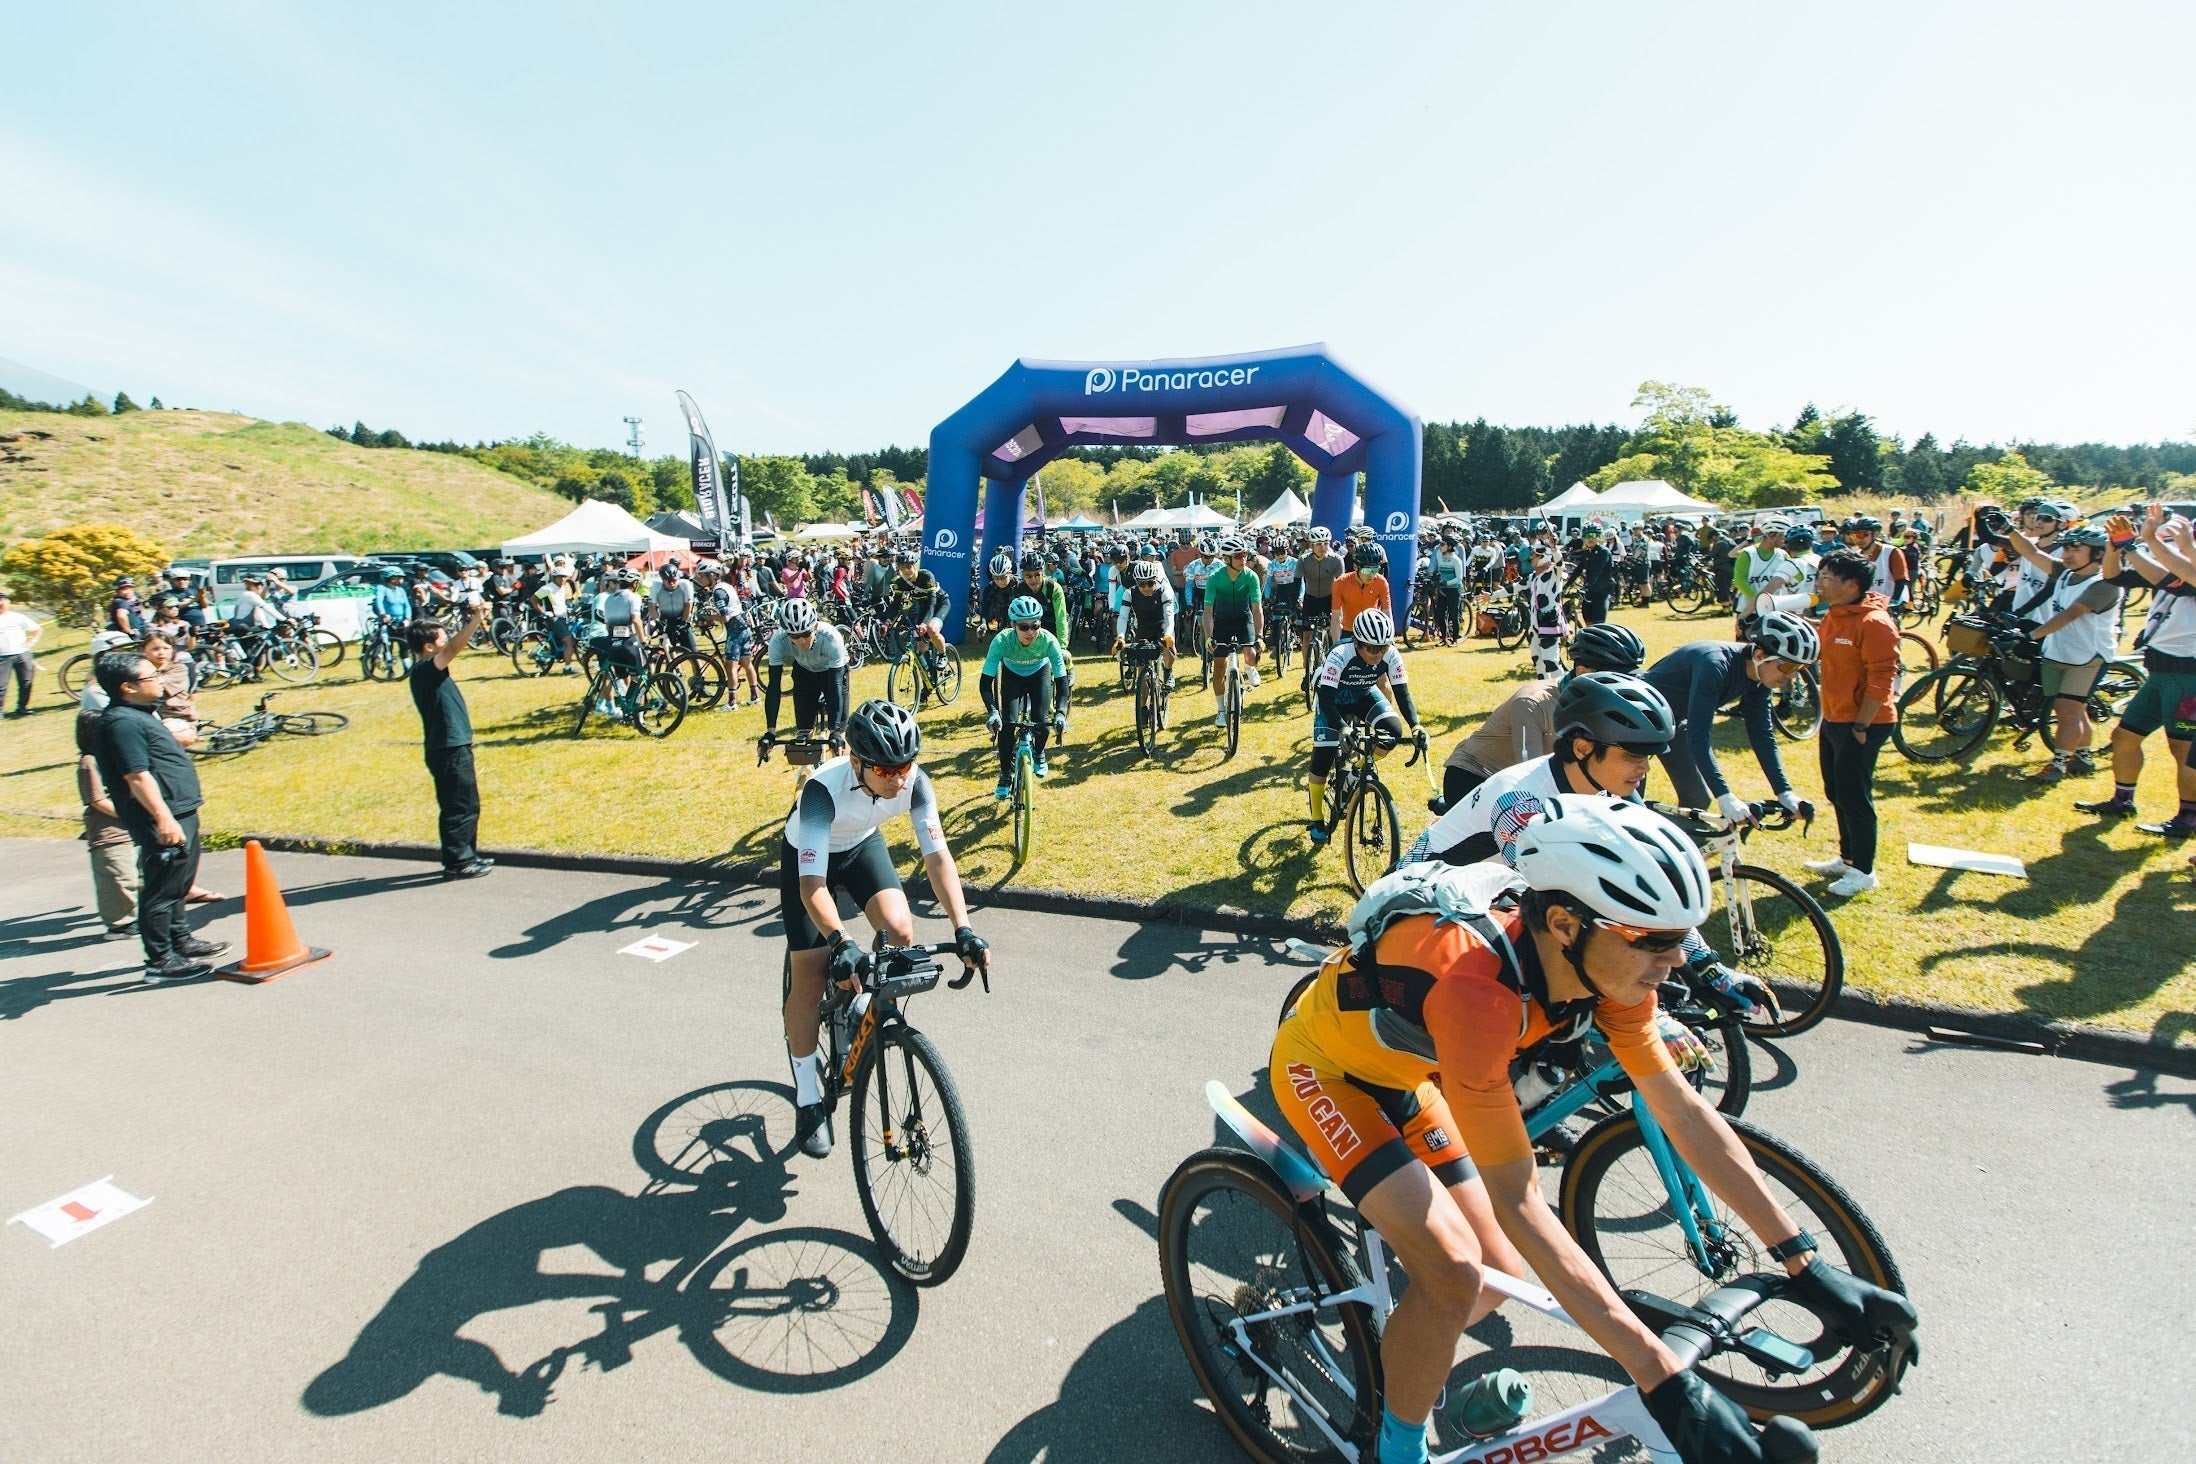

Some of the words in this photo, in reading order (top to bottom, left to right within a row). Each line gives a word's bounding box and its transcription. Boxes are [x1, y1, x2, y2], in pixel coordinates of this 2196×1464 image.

[1121, 366, 1260, 392] Panaracer
[923, 546, 966, 559] Panaracer
[843, 1000, 876, 1087] RIDLEY
[1286, 1062, 1323, 1102] YU
[1308, 1095, 1362, 1160] CAN
[1461, 1415, 1613, 1464] RBEA
